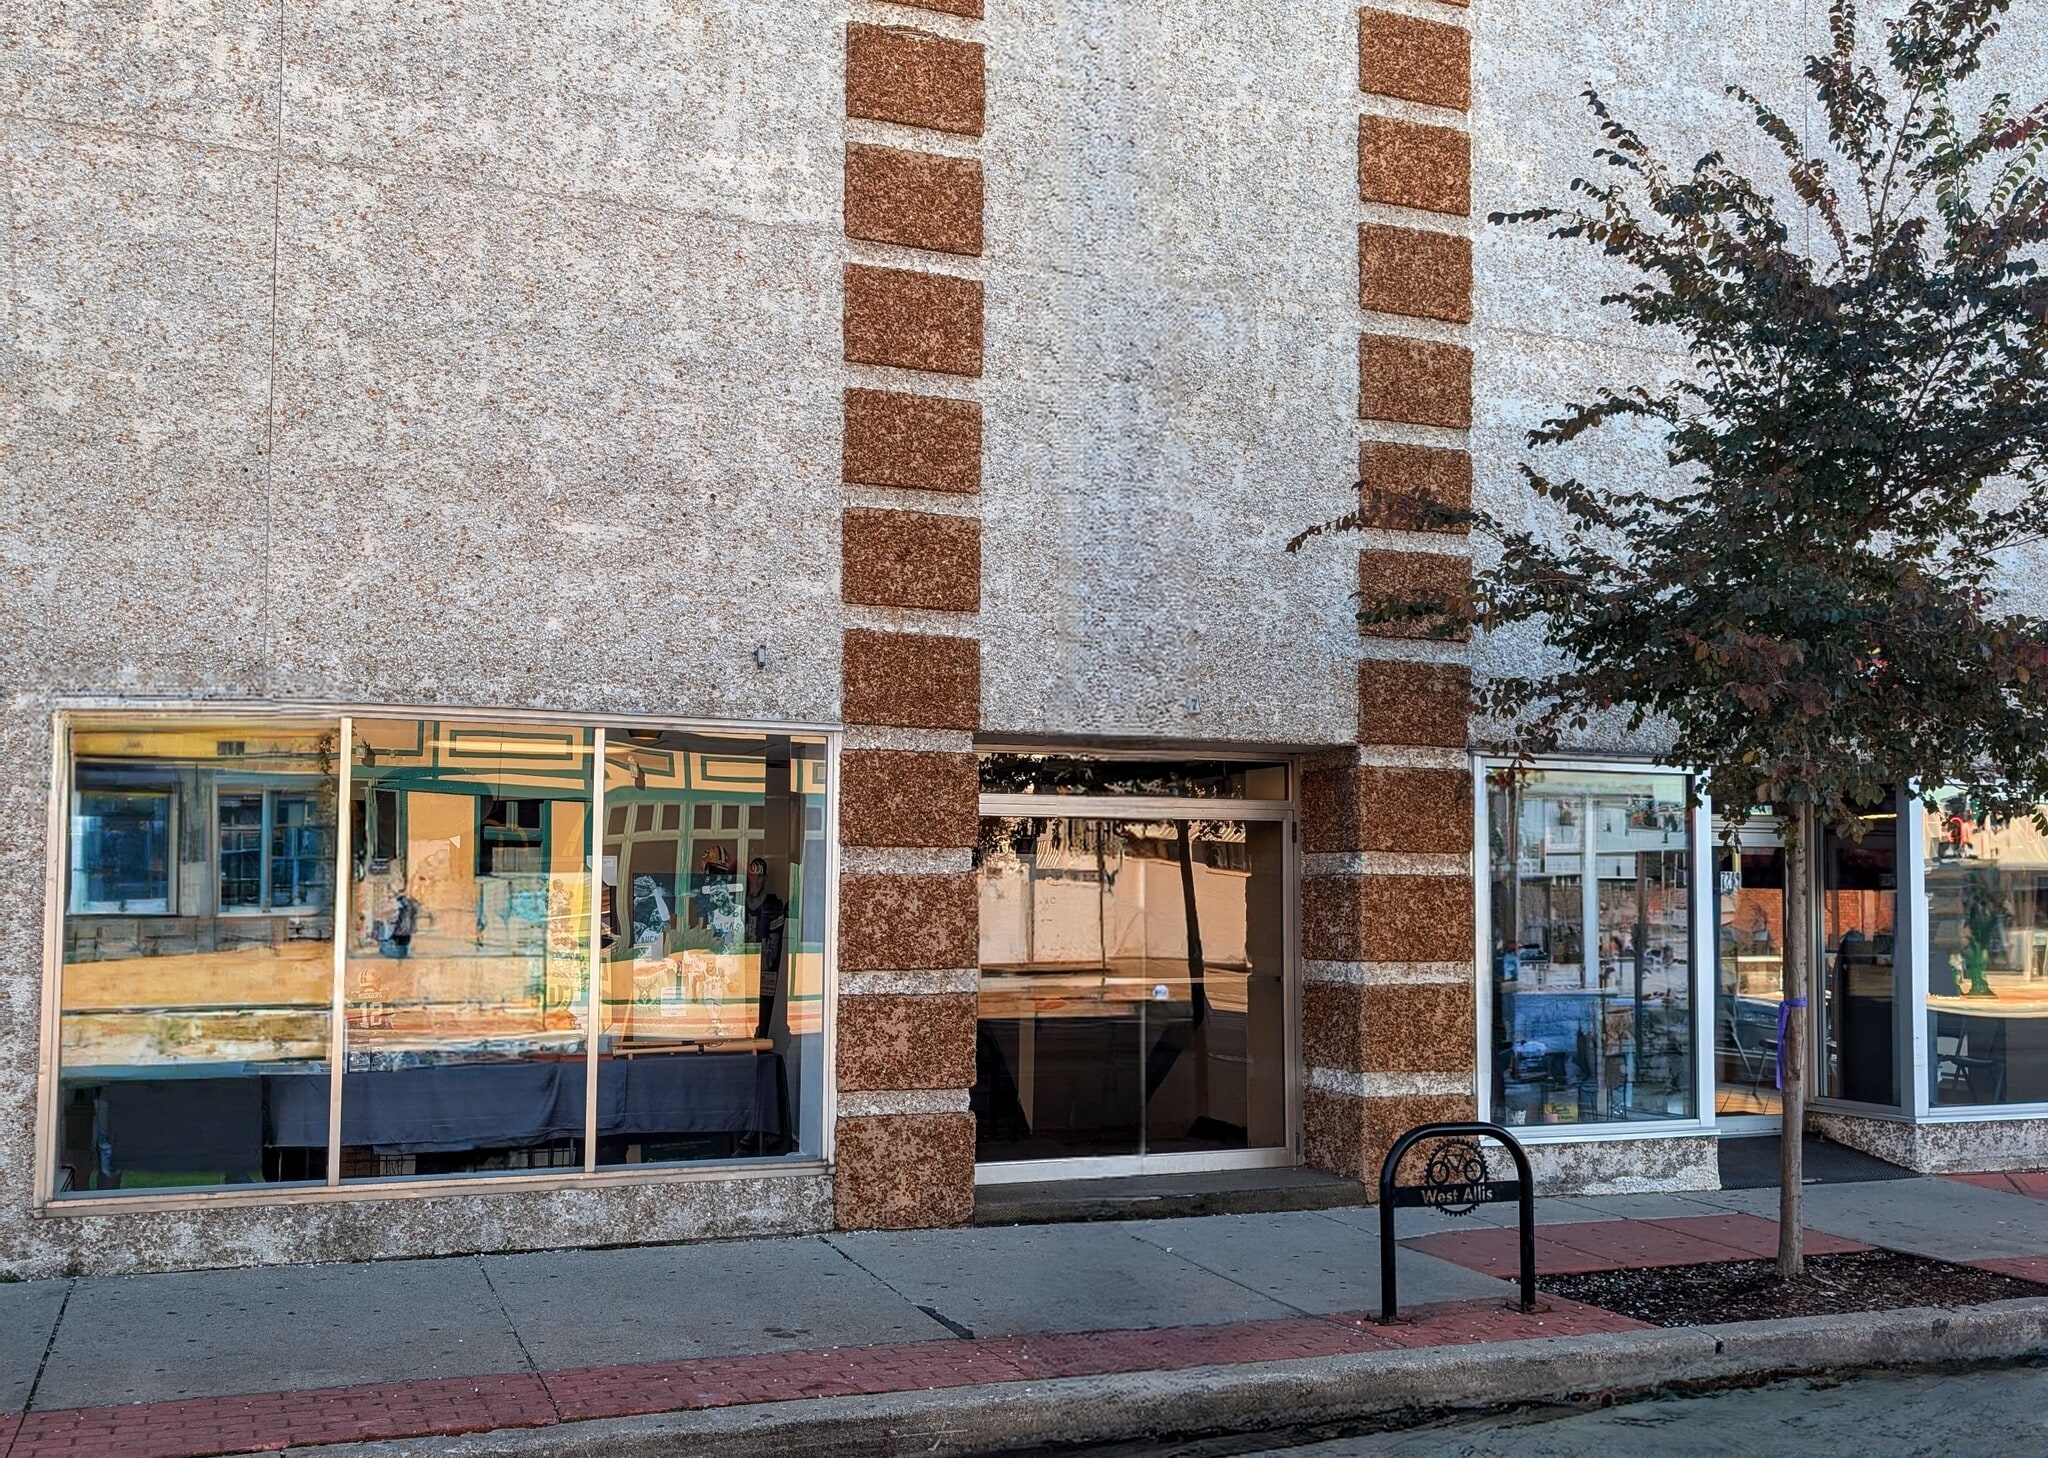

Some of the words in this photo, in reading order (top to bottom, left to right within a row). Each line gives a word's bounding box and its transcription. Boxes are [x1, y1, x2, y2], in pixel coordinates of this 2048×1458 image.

[360, 1002, 383, 1028] 12
[1421, 1189, 1459, 1204] West
[1463, 1185, 1493, 1202] Allis
